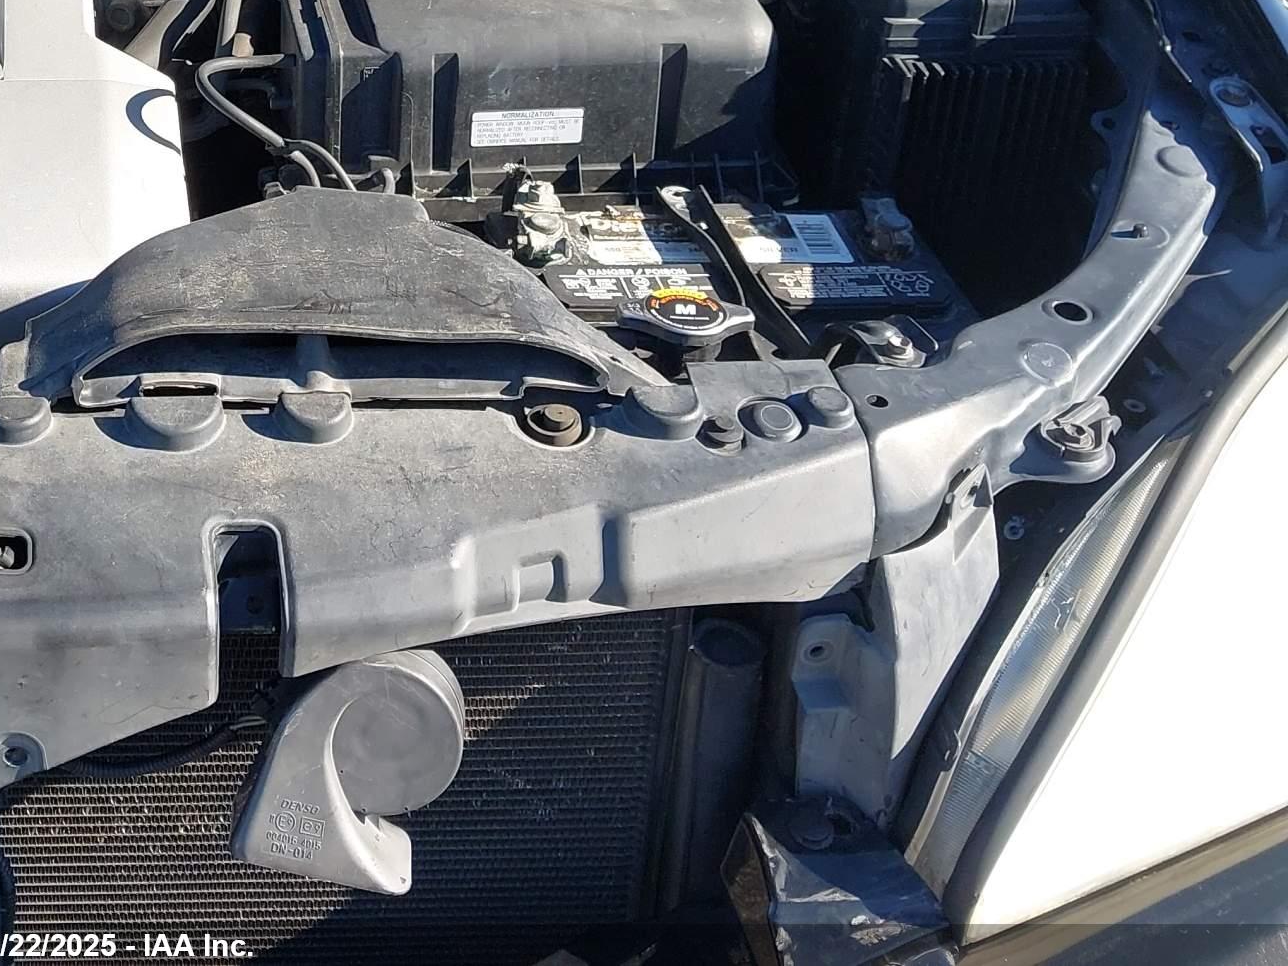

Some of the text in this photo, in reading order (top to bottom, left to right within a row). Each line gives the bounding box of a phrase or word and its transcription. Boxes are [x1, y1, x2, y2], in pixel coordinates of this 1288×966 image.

[501, 111, 555, 119] NORMALIZATION
[588, 268, 634, 276] DANGER
[280, 798, 321, 815] DENSO
